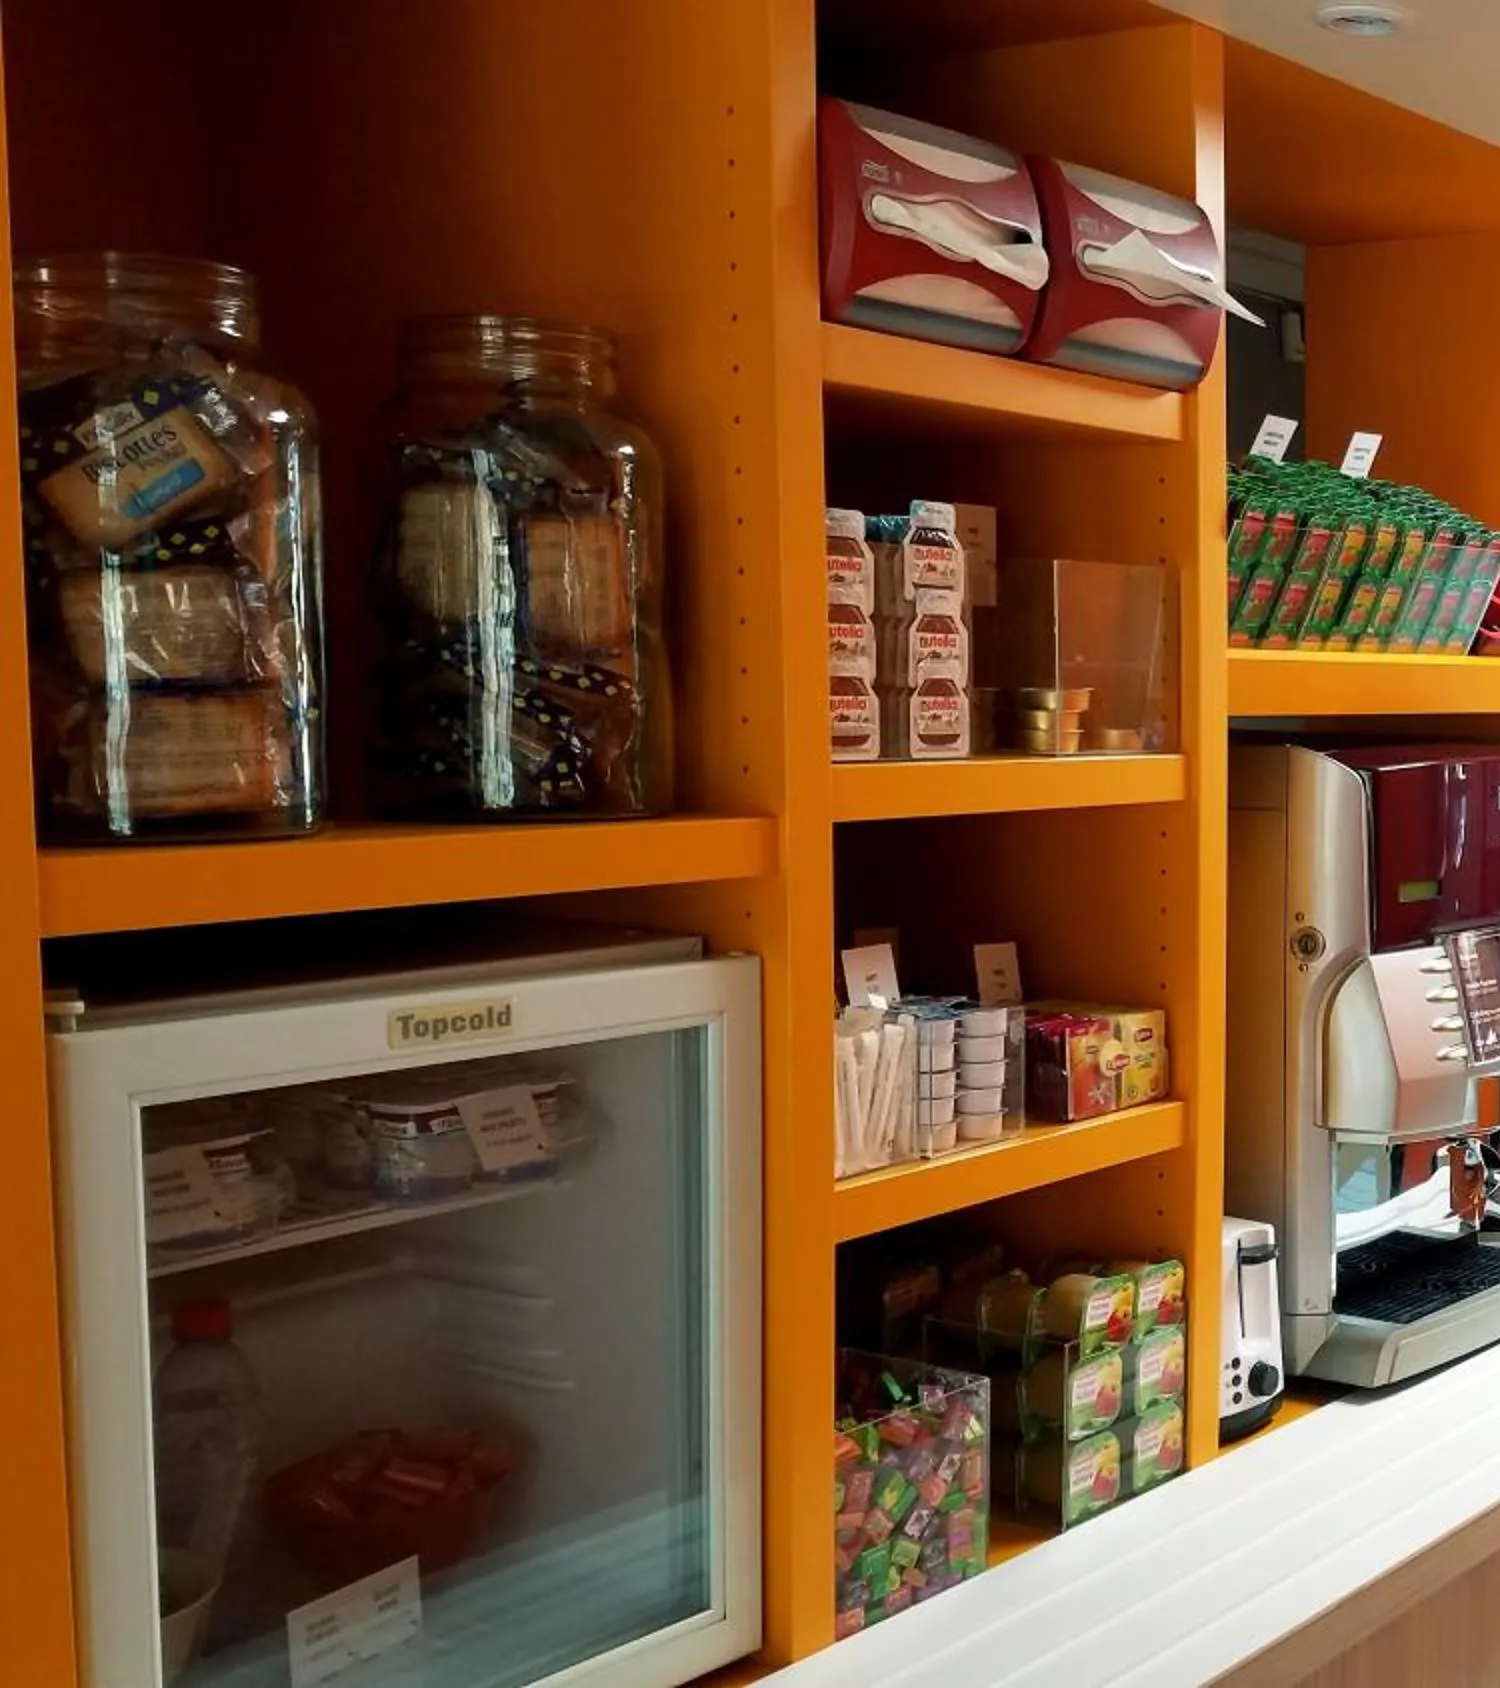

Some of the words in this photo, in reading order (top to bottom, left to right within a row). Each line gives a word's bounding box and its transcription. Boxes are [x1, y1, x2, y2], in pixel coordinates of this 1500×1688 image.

[82, 424, 178, 484] Bcottes
[828, 559, 862, 573] utella
[919, 635, 957, 648] nutella
[396, 1004, 512, 1040] Topcold
